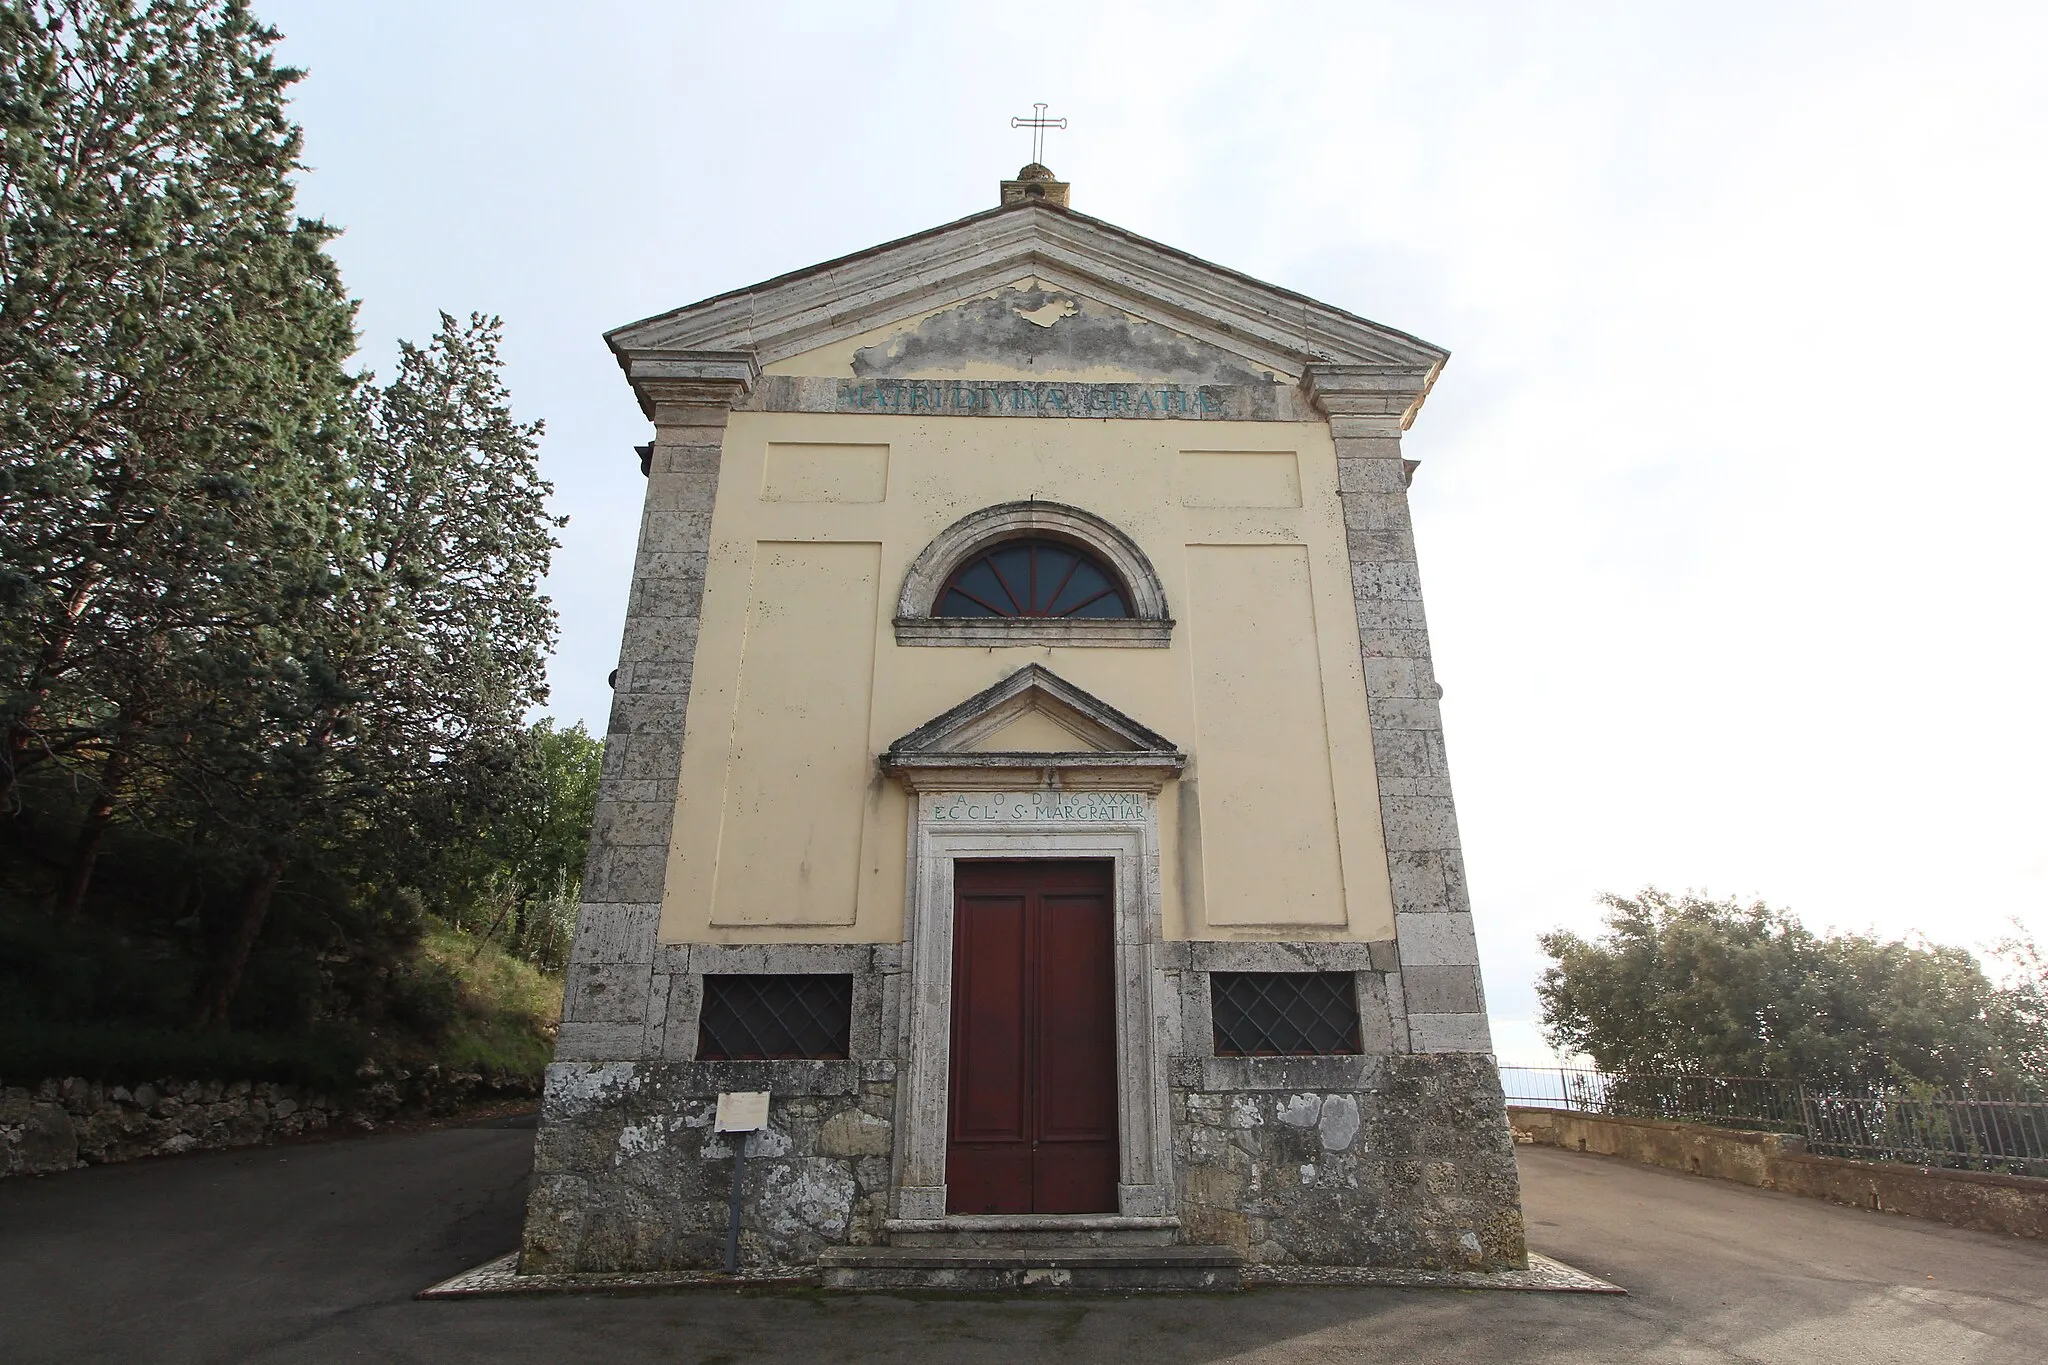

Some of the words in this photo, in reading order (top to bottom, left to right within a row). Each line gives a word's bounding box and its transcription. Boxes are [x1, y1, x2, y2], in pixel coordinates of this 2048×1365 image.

[838, 385, 943, 408] MATRI
[956, 794, 968, 806] A
[993, 793, 1005, 806] O
[1032, 792, 1043, 805] D
